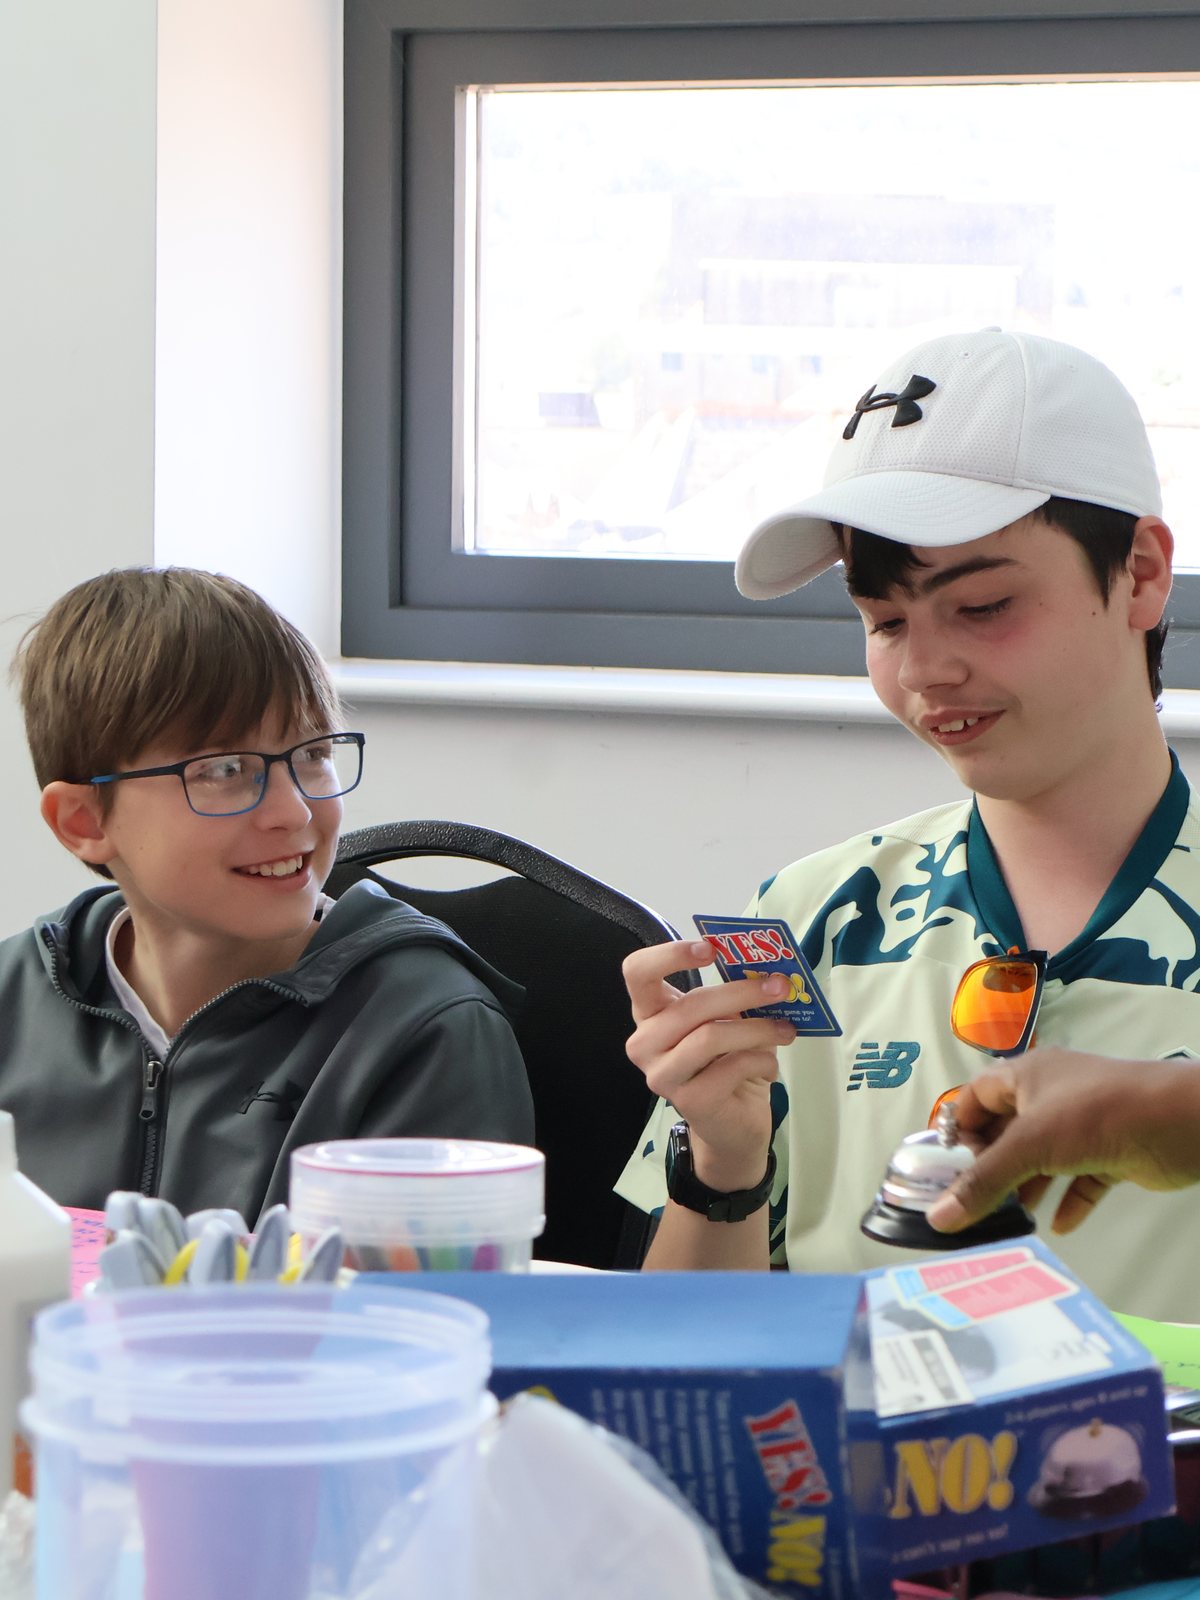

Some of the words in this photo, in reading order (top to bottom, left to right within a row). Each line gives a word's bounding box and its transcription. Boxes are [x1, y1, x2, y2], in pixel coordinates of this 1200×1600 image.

[703, 929, 794, 965] YES!
[847, 1041, 921, 1092] NB
[743, 1399, 834, 1511] YES!
[890, 1430, 1018, 1520] NO!
[766, 1510, 828, 1589] NO!
